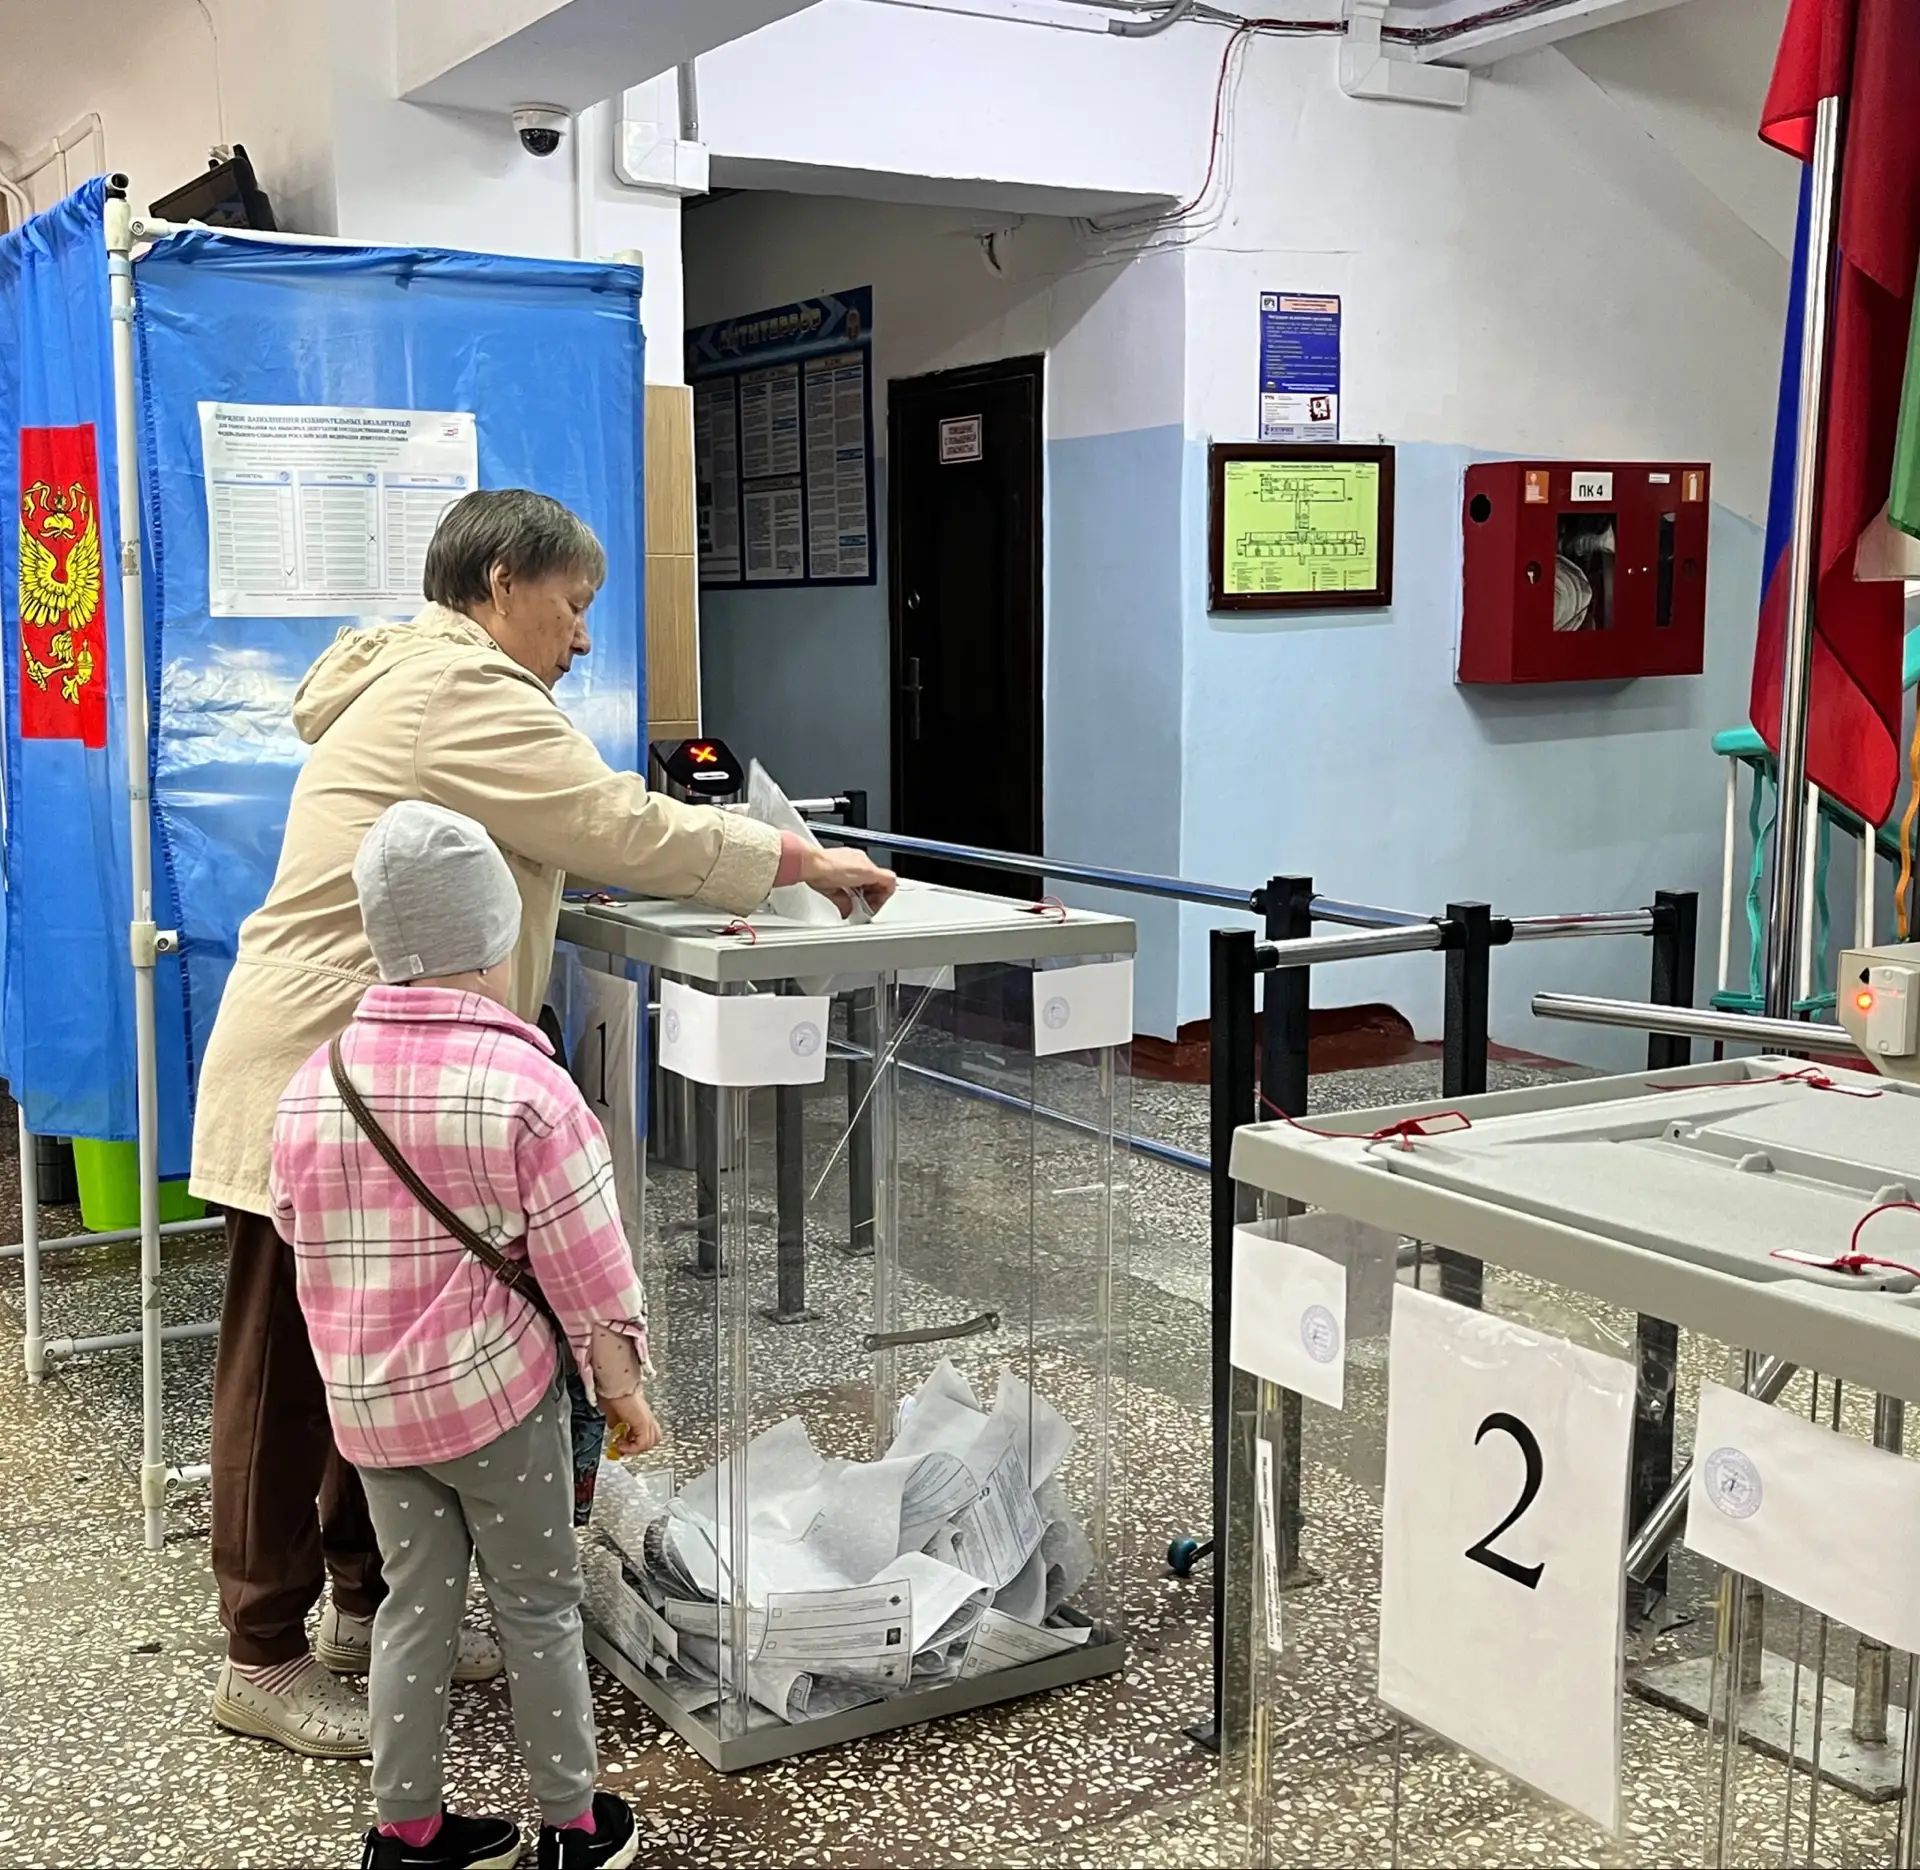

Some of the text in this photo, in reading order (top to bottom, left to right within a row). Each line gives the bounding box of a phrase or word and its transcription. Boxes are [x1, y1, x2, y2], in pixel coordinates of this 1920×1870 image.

[1579, 485, 1603, 498] ПК 4
[596, 1021, 610, 1107] 1
[1464, 1411, 1546, 1591] 2
